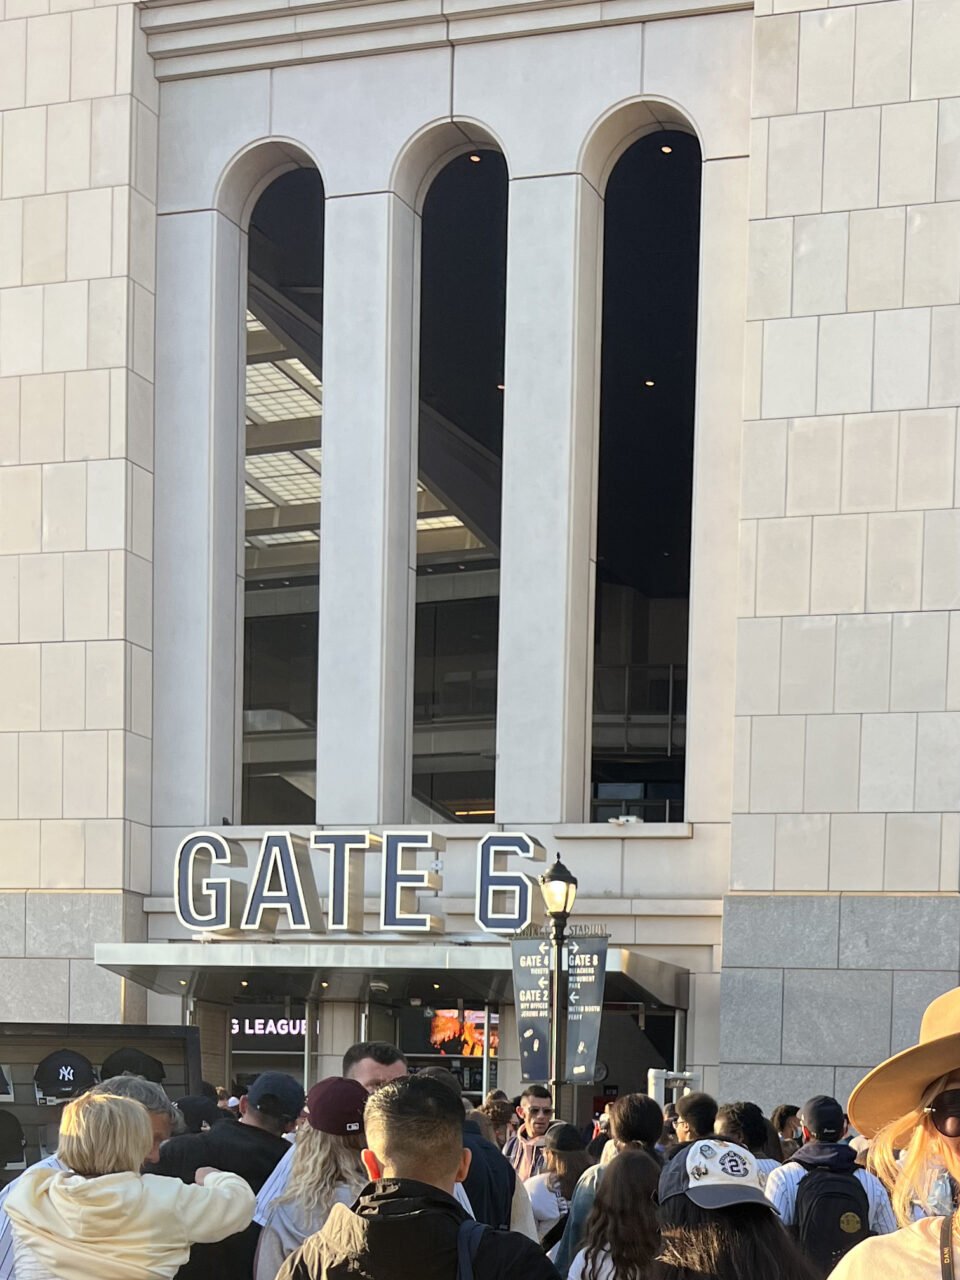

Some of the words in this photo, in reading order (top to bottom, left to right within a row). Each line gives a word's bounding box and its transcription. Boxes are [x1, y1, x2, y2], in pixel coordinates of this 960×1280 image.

[174, 830, 433, 931] GATE
[474, 831, 534, 934] 6
[519, 955, 542, 967] GATE
[543, 955, 549, 967] 4
[568, 954, 591, 966] GATE
[519, 989, 542, 1001] GATE
[542, 989, 549, 1001] 2
[244, 1018, 307, 1035] LEAGUE
[59, 1066, 75, 1081] NY
[727, 1158, 742, 1173] 2
